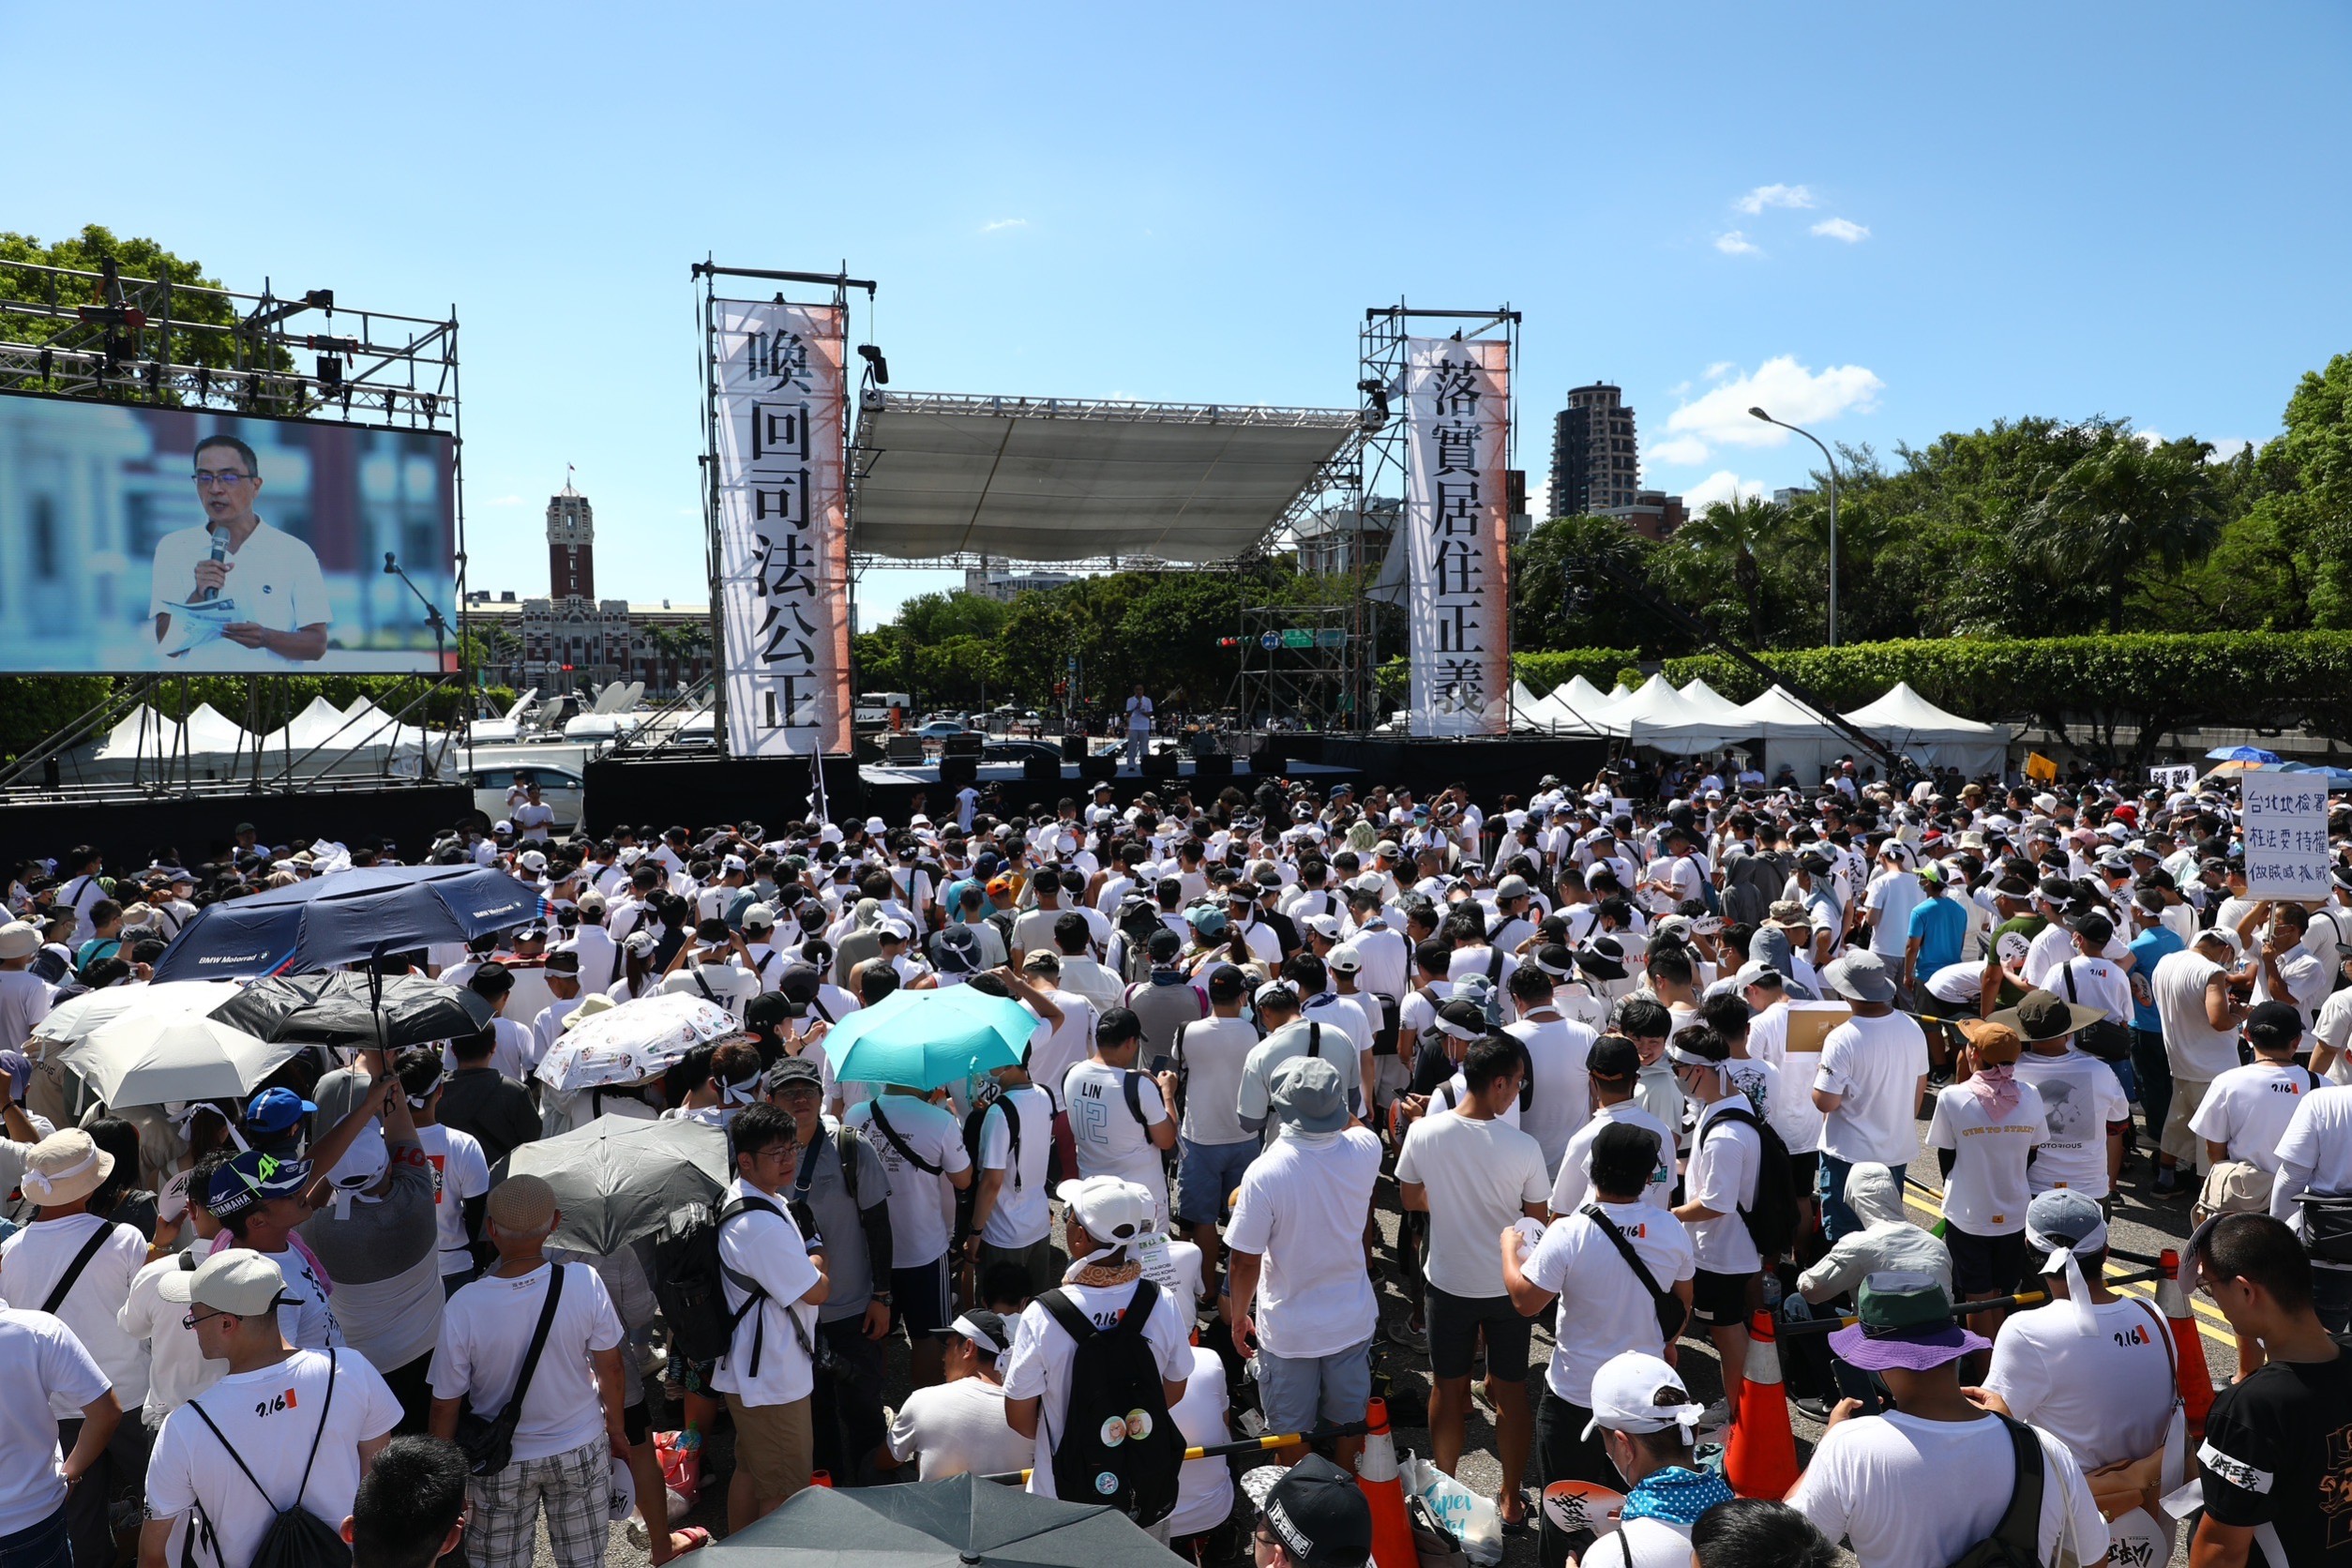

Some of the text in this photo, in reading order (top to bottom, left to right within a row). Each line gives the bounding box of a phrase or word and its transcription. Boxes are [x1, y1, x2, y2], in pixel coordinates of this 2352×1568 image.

[749, 328, 822, 730] 喚回司法公正
[1431, 359, 1485, 715] 落實居住正義
[2248, 790, 2325, 814] 台北地檢署
[220, 953, 257, 963] Motorrad
[1081, 1081, 1102, 1099] LIN
[2271, 1083, 2291, 1093] 7.16
[1073, 1098, 1108, 1144] 12
[215, 1193, 251, 1214] YAMAHA
[1093, 1311, 1118, 1326] 7.16
[2114, 1329, 2141, 1348] 7.16
[255, 1395, 286, 1418] 7.16
